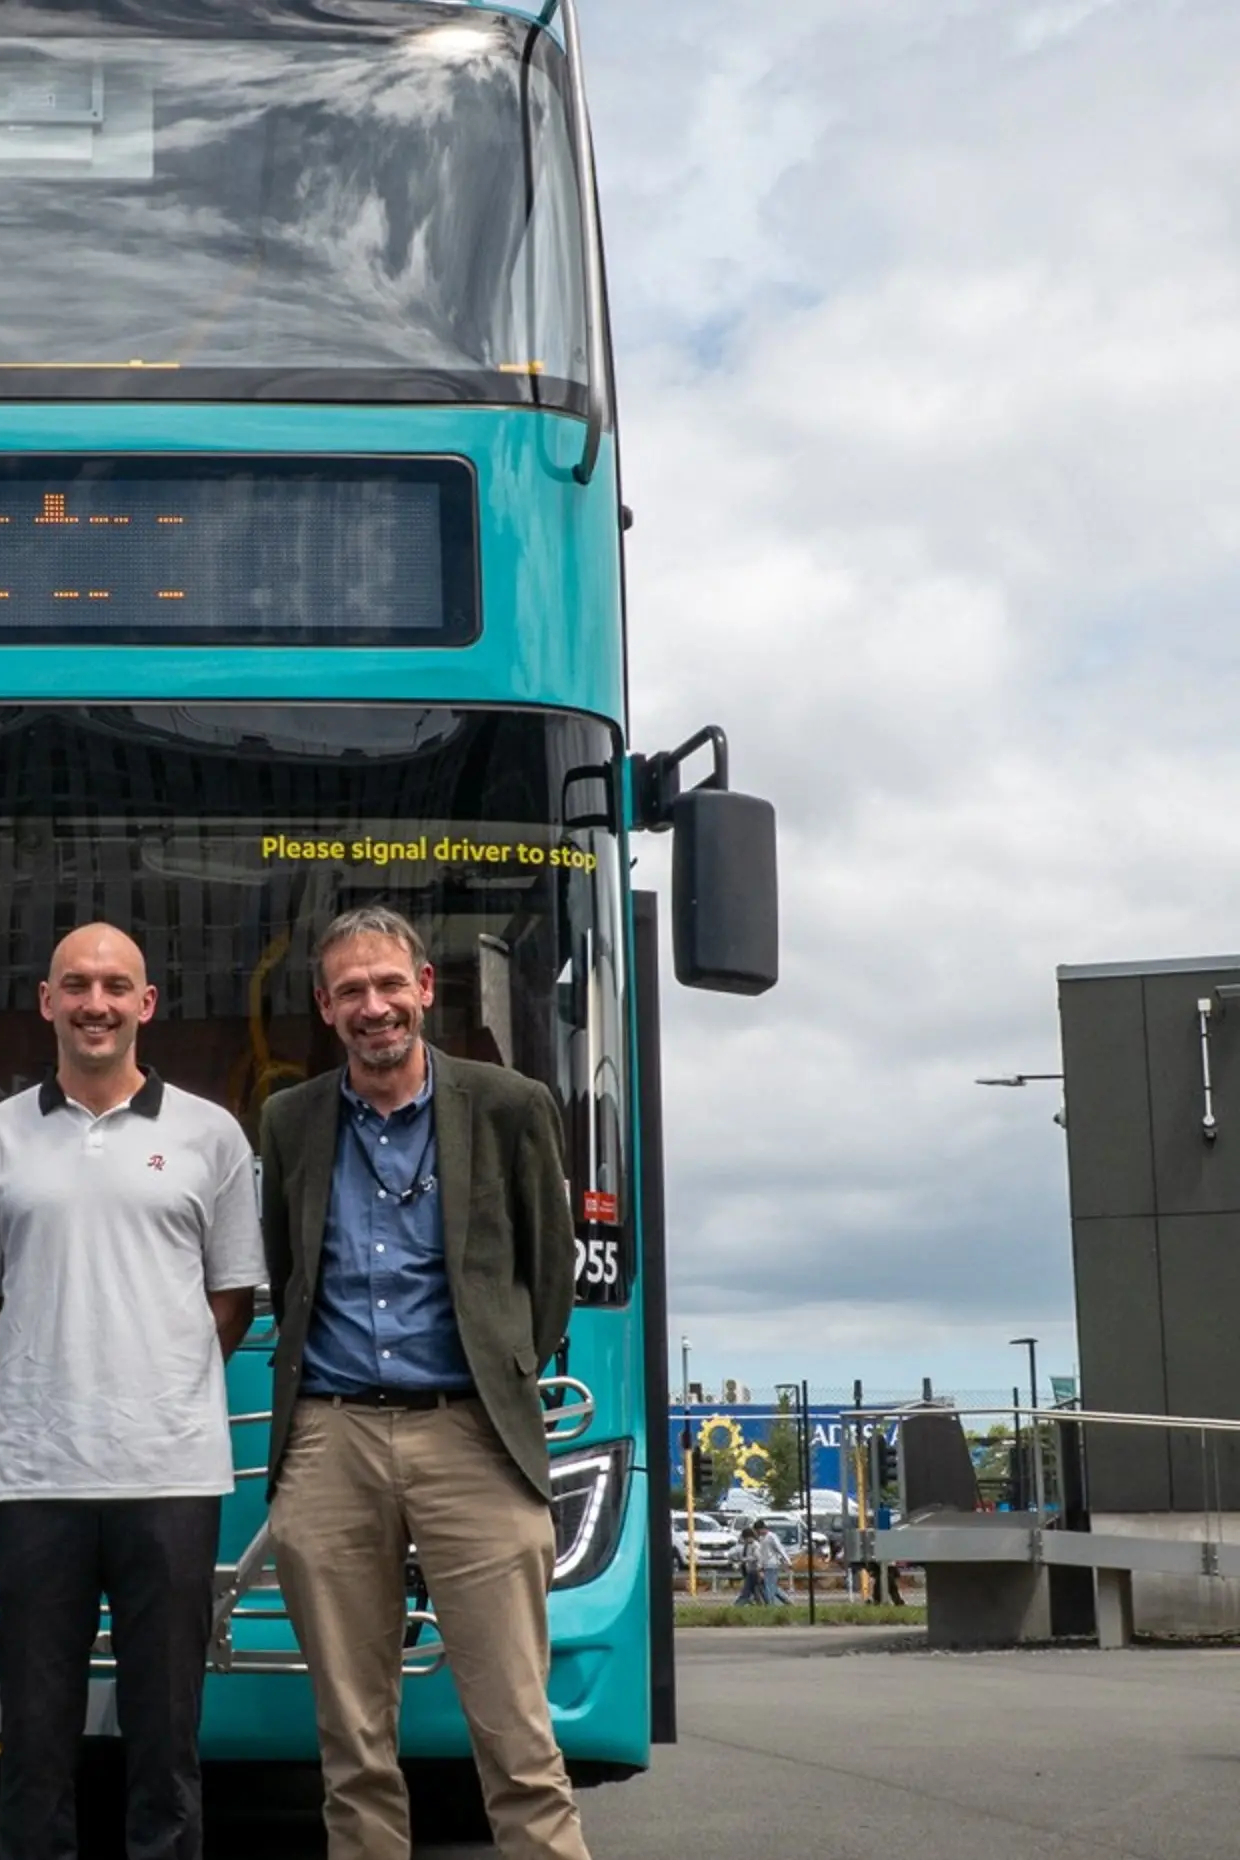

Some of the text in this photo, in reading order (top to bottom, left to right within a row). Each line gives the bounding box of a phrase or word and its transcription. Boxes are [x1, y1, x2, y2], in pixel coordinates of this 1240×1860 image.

[262, 834, 596, 874] Please signal driver to stop
